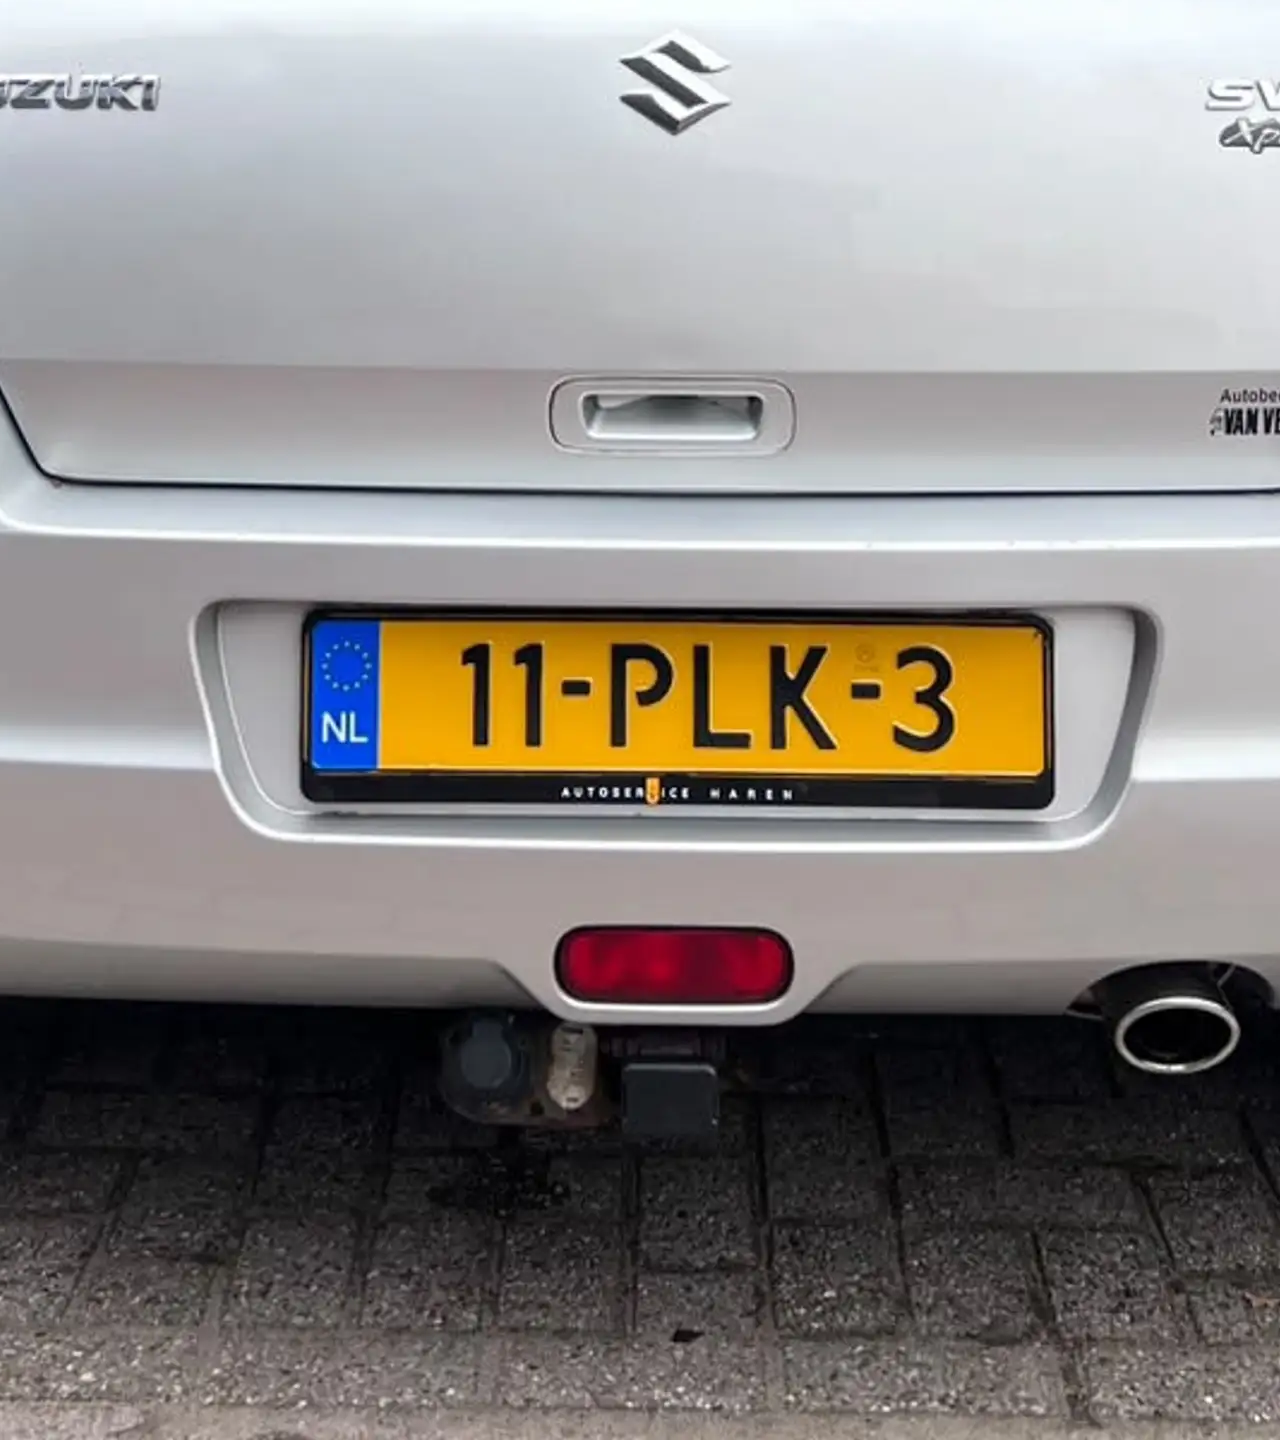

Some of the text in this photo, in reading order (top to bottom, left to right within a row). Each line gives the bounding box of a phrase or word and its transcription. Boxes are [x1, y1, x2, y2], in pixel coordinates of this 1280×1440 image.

[1224, 407, 1259, 435] VAN
[461, 643, 956, 753] 11-PLK-3
[321, 711, 369, 744] NL
[561, 786, 793, 801] AUTOSERICE HAREN
